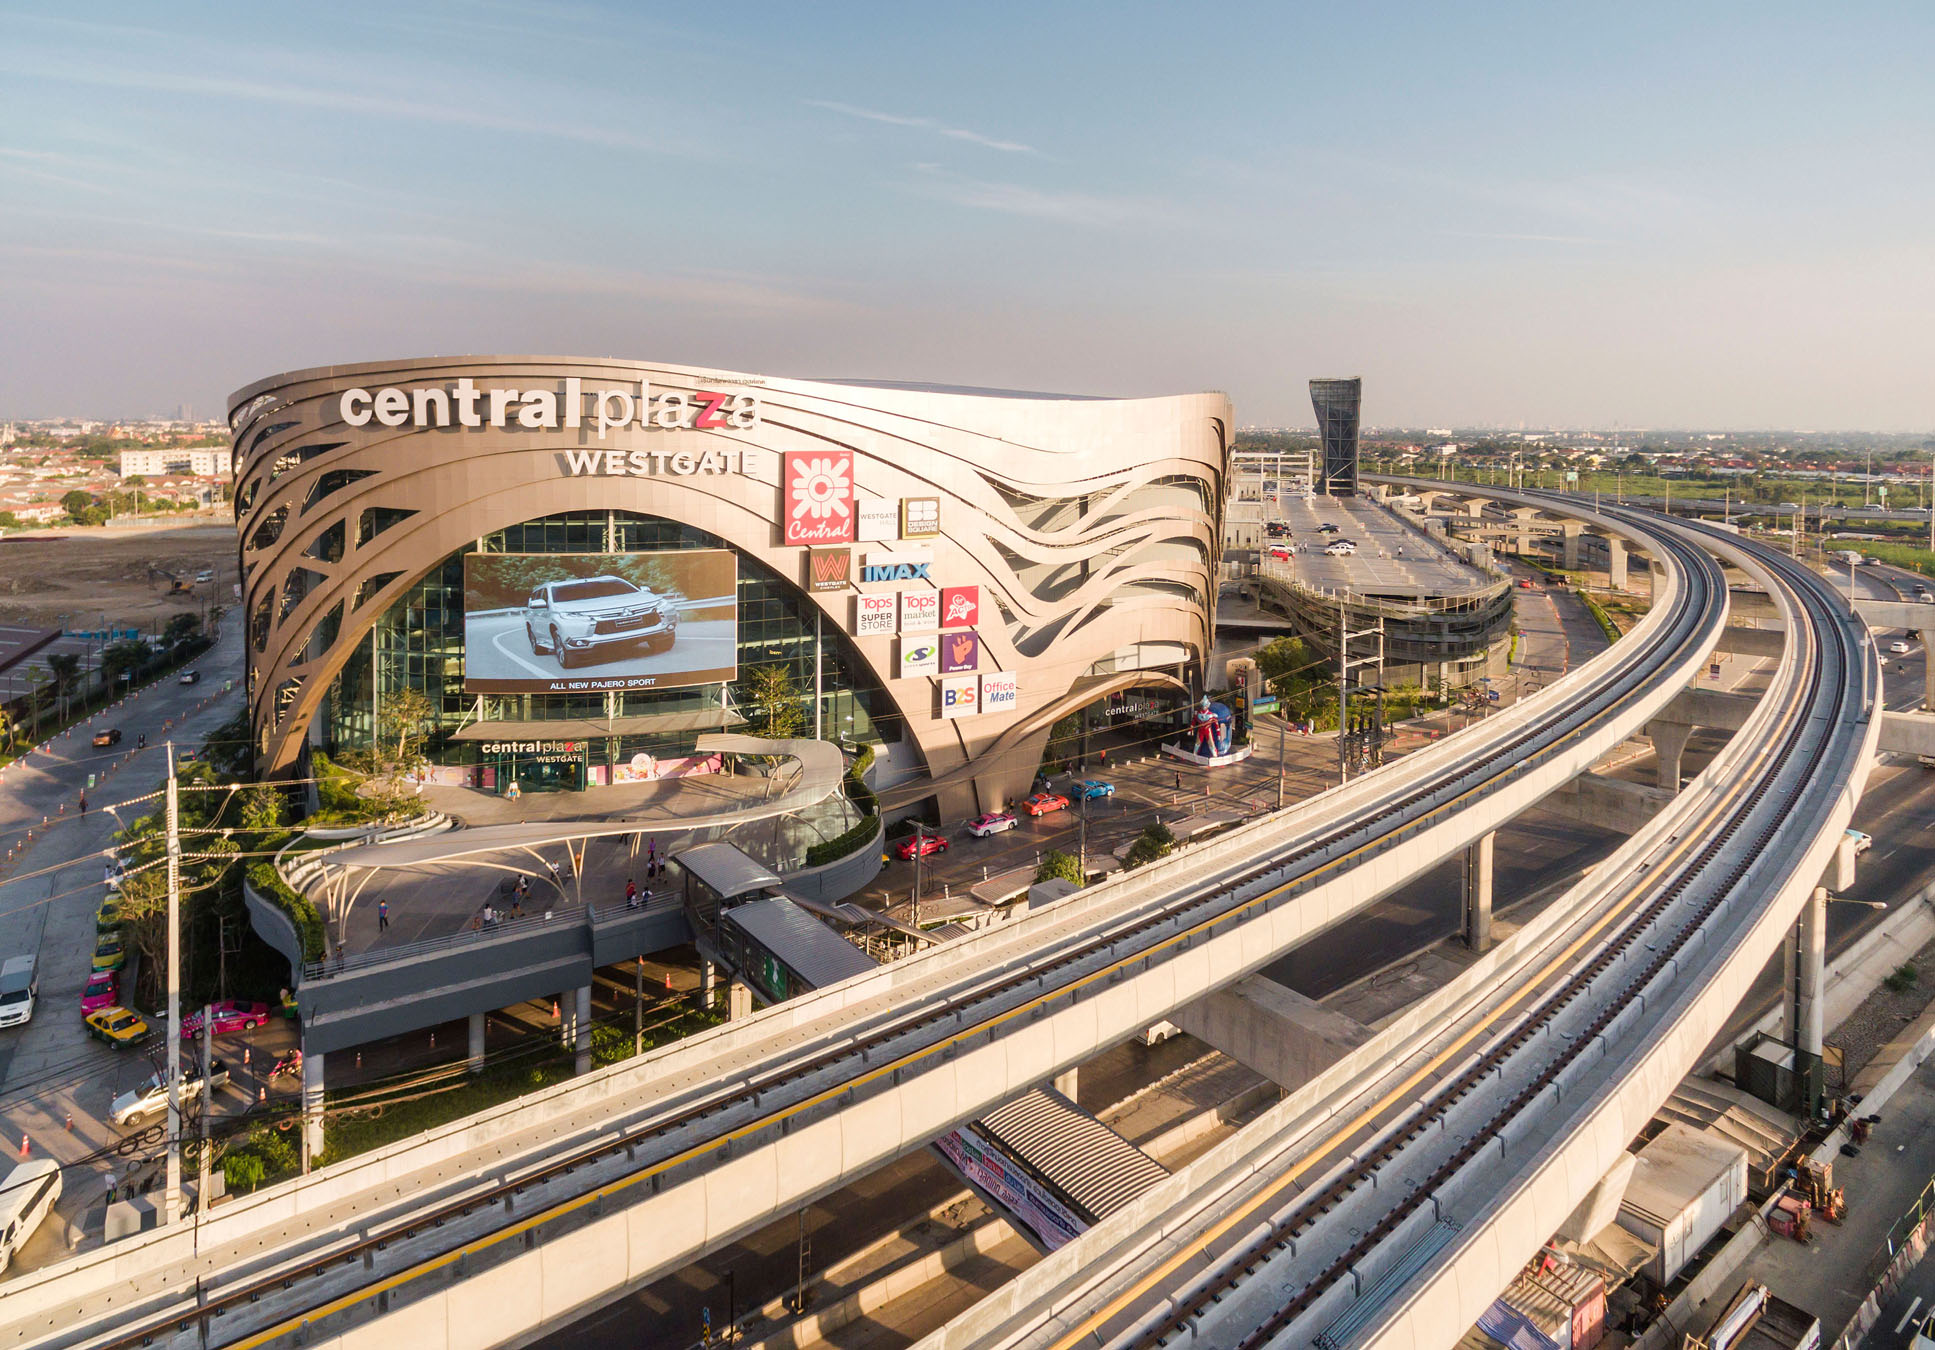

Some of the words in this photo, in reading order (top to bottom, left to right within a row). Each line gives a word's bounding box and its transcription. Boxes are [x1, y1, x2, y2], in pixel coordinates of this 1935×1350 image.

[565, 450, 757, 475] WESTGATE
[788, 518, 850, 540] Central
[865, 563, 931, 582] IMAX
[861, 598, 893, 612] Tops
[904, 596, 936, 611] Tops
[861, 612, 893, 621] SUPER
[904, 610, 936, 620] market
[861, 620, 893, 630] STORE
[591, 680, 625, 688] PAJERO
[627, 678, 656, 687] SPORT
[984, 682, 1014, 693] Office
[945, 687, 975, 706] B2S
[990, 691, 1015, 703] Mate
[536, 755, 583, 763] WESTGATE
